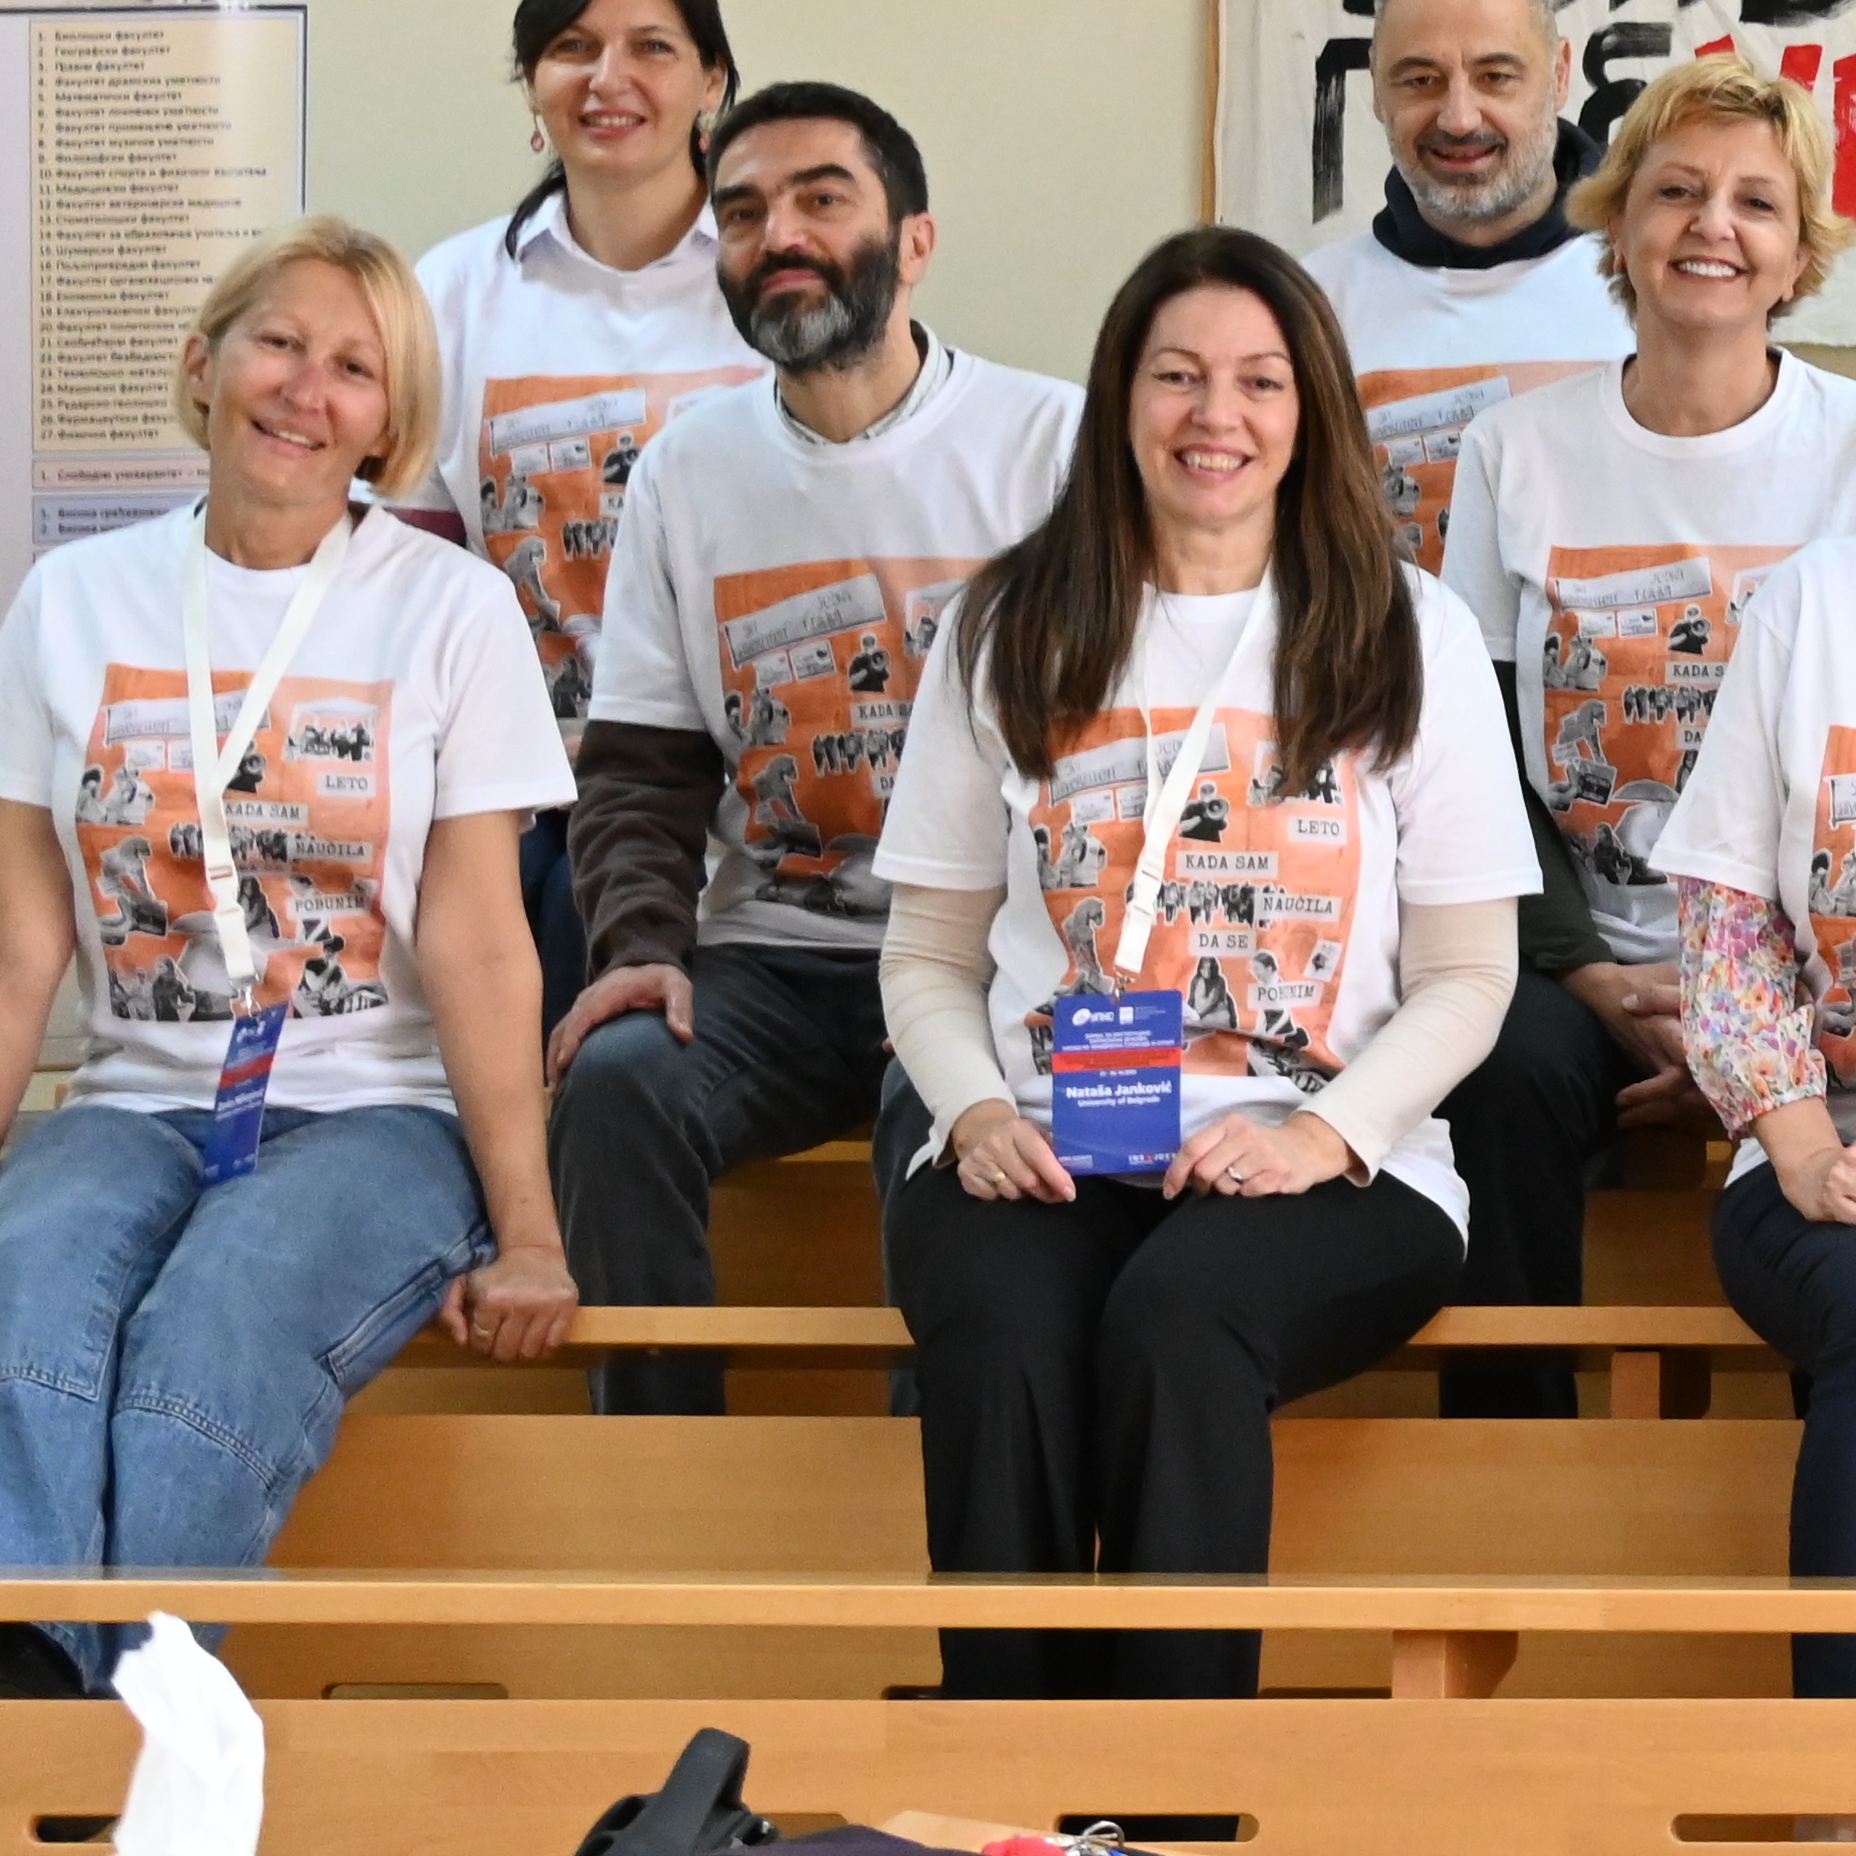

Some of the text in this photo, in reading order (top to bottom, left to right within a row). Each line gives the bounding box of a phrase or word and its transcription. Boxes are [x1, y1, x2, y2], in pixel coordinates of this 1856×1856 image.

[1673, 664, 1710, 677] KADA
[325, 774, 369, 790] LETO
[270, 804, 301, 820] SAM
[1297, 819, 1340, 836] LETO
[1185, 854, 1269, 871] KADA SAM
[1263, 894, 1333, 914] NAUČILA
[1198, 933, 1249, 949] DA SE
[1066, 1080, 1173, 1099] Nataša Janković
